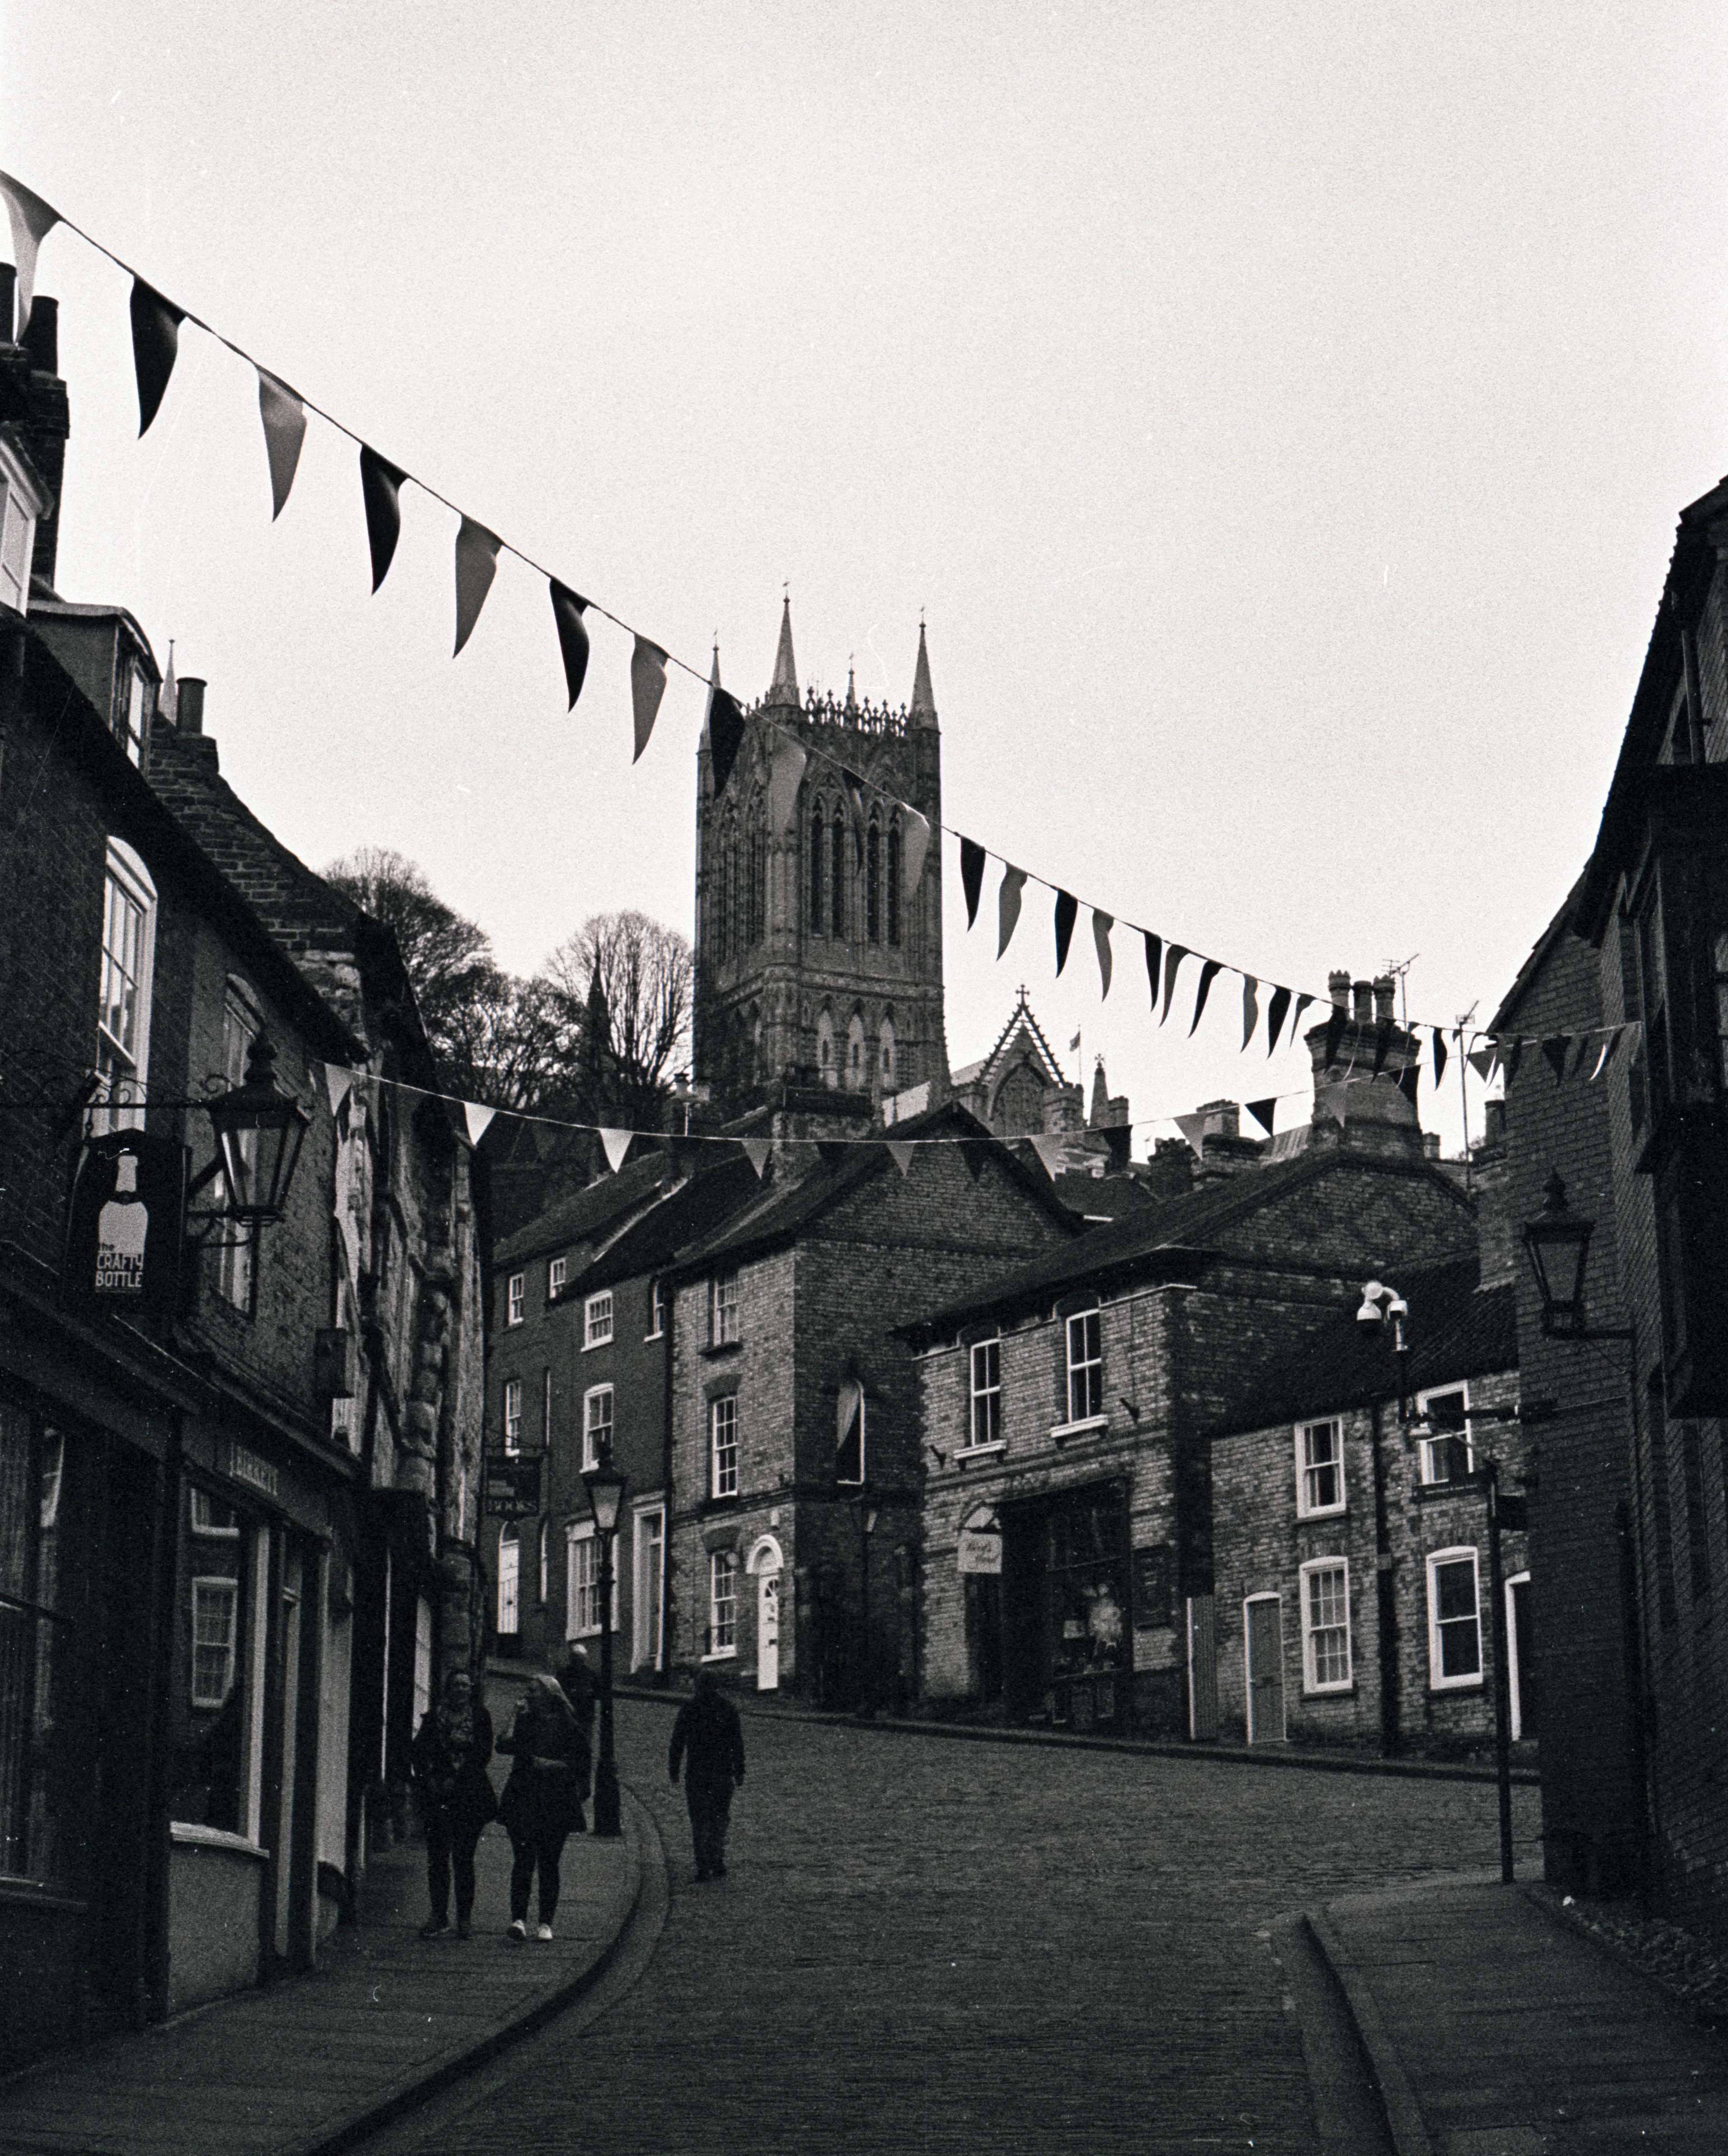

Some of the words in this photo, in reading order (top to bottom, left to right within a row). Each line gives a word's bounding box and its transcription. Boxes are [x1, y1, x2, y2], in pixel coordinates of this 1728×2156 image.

[97, 1253, 144, 1271] CRAFTY
[95, 1271, 143, 1288] BOTTLE
[487, 1498, 537, 1512] BOOKS
